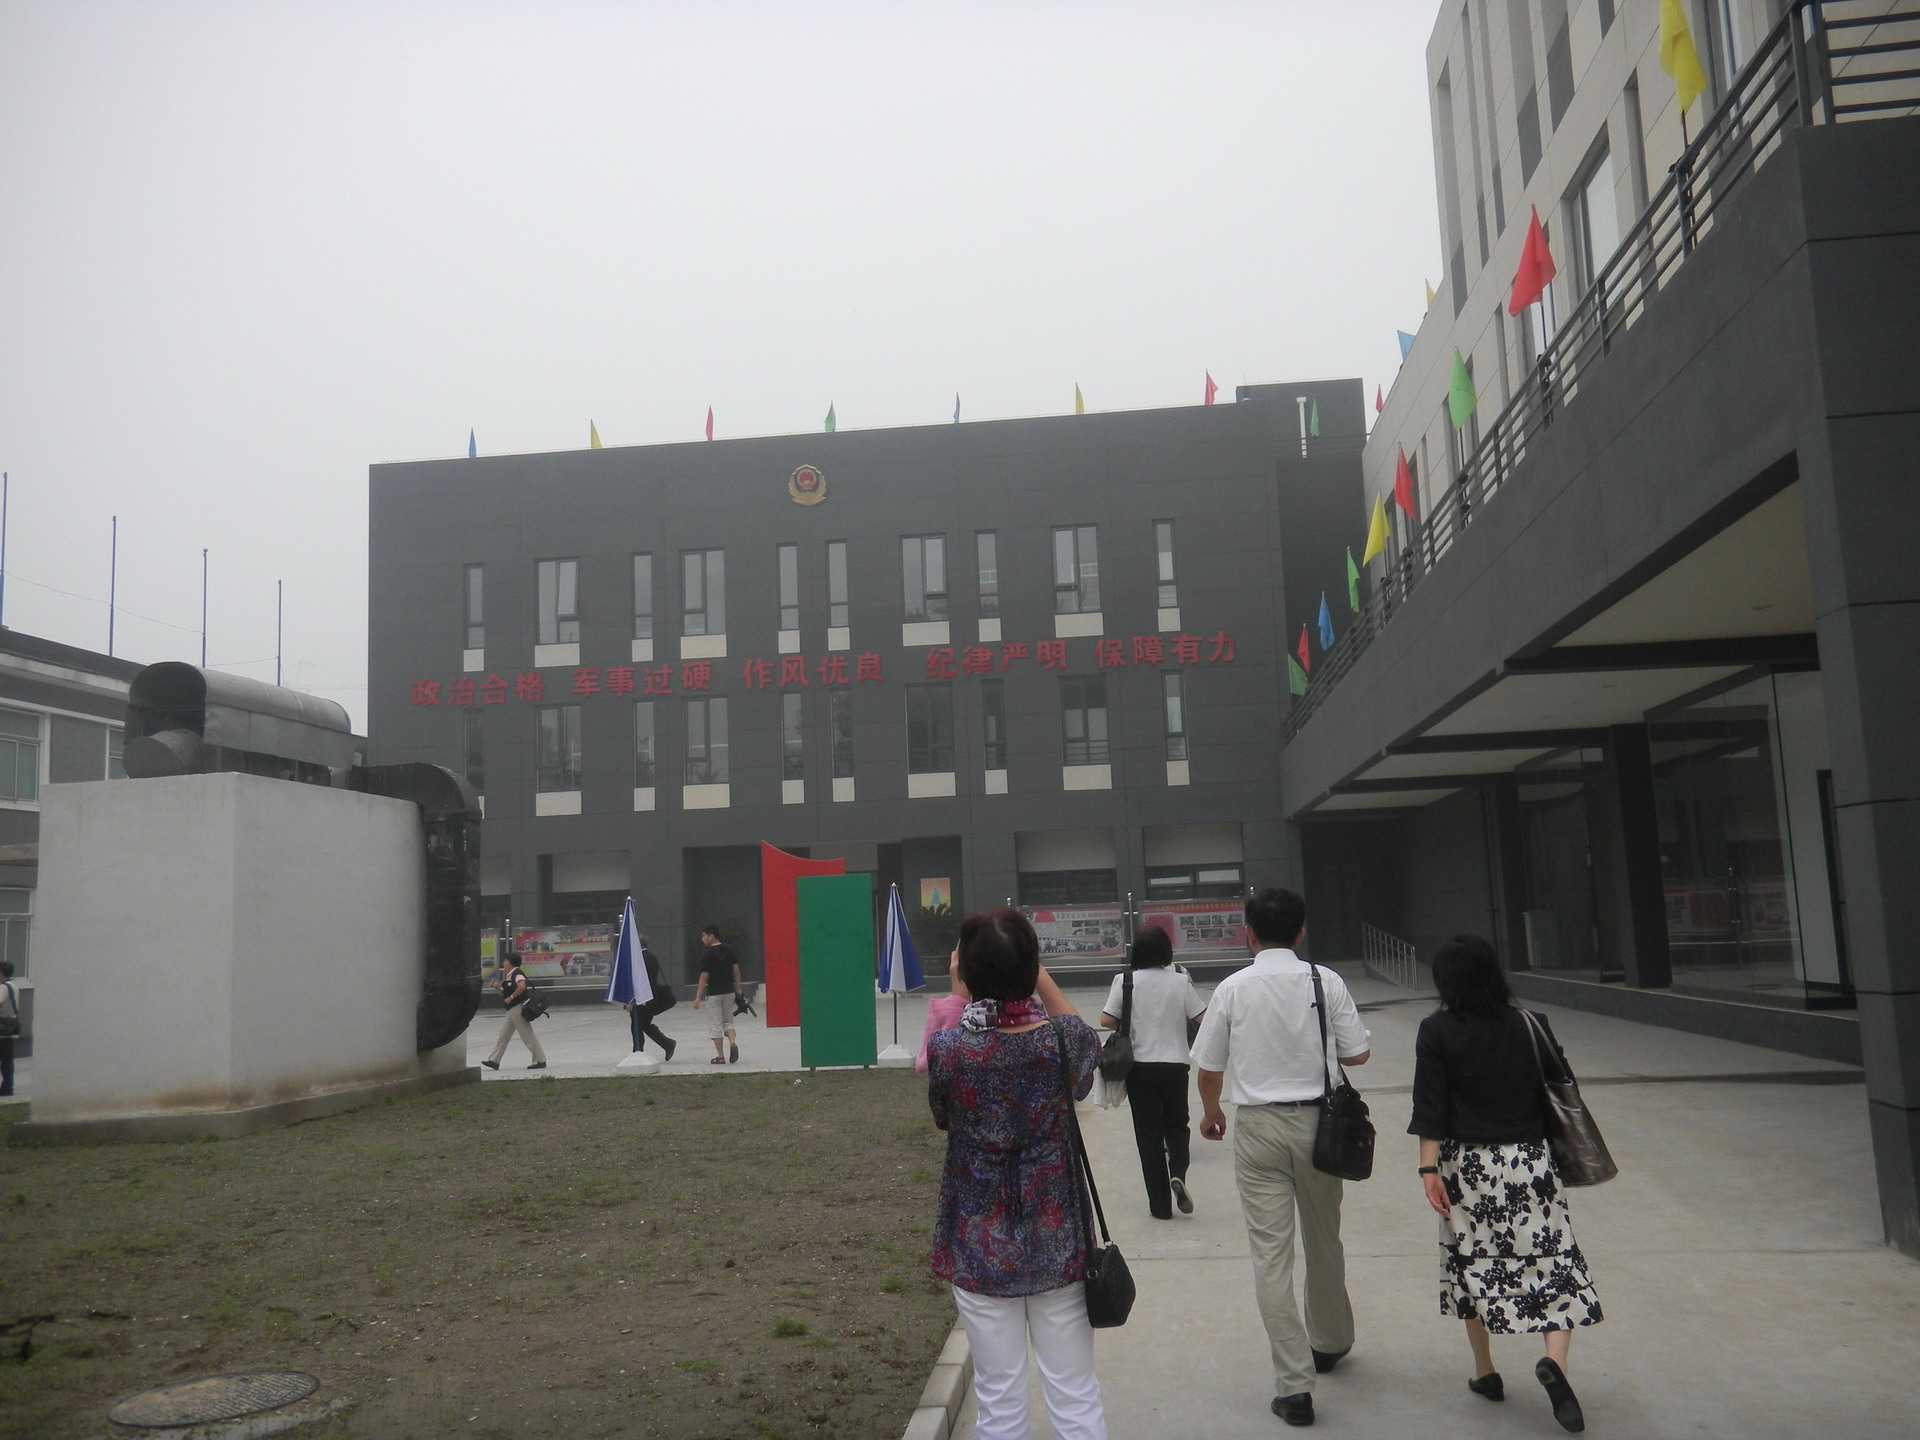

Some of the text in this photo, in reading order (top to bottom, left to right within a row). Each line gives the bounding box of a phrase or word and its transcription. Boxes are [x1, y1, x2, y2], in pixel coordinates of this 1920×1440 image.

[411, 632, 1235, 707] 政治合格 军事过硬 作风优良 纪律严明 保障有力
